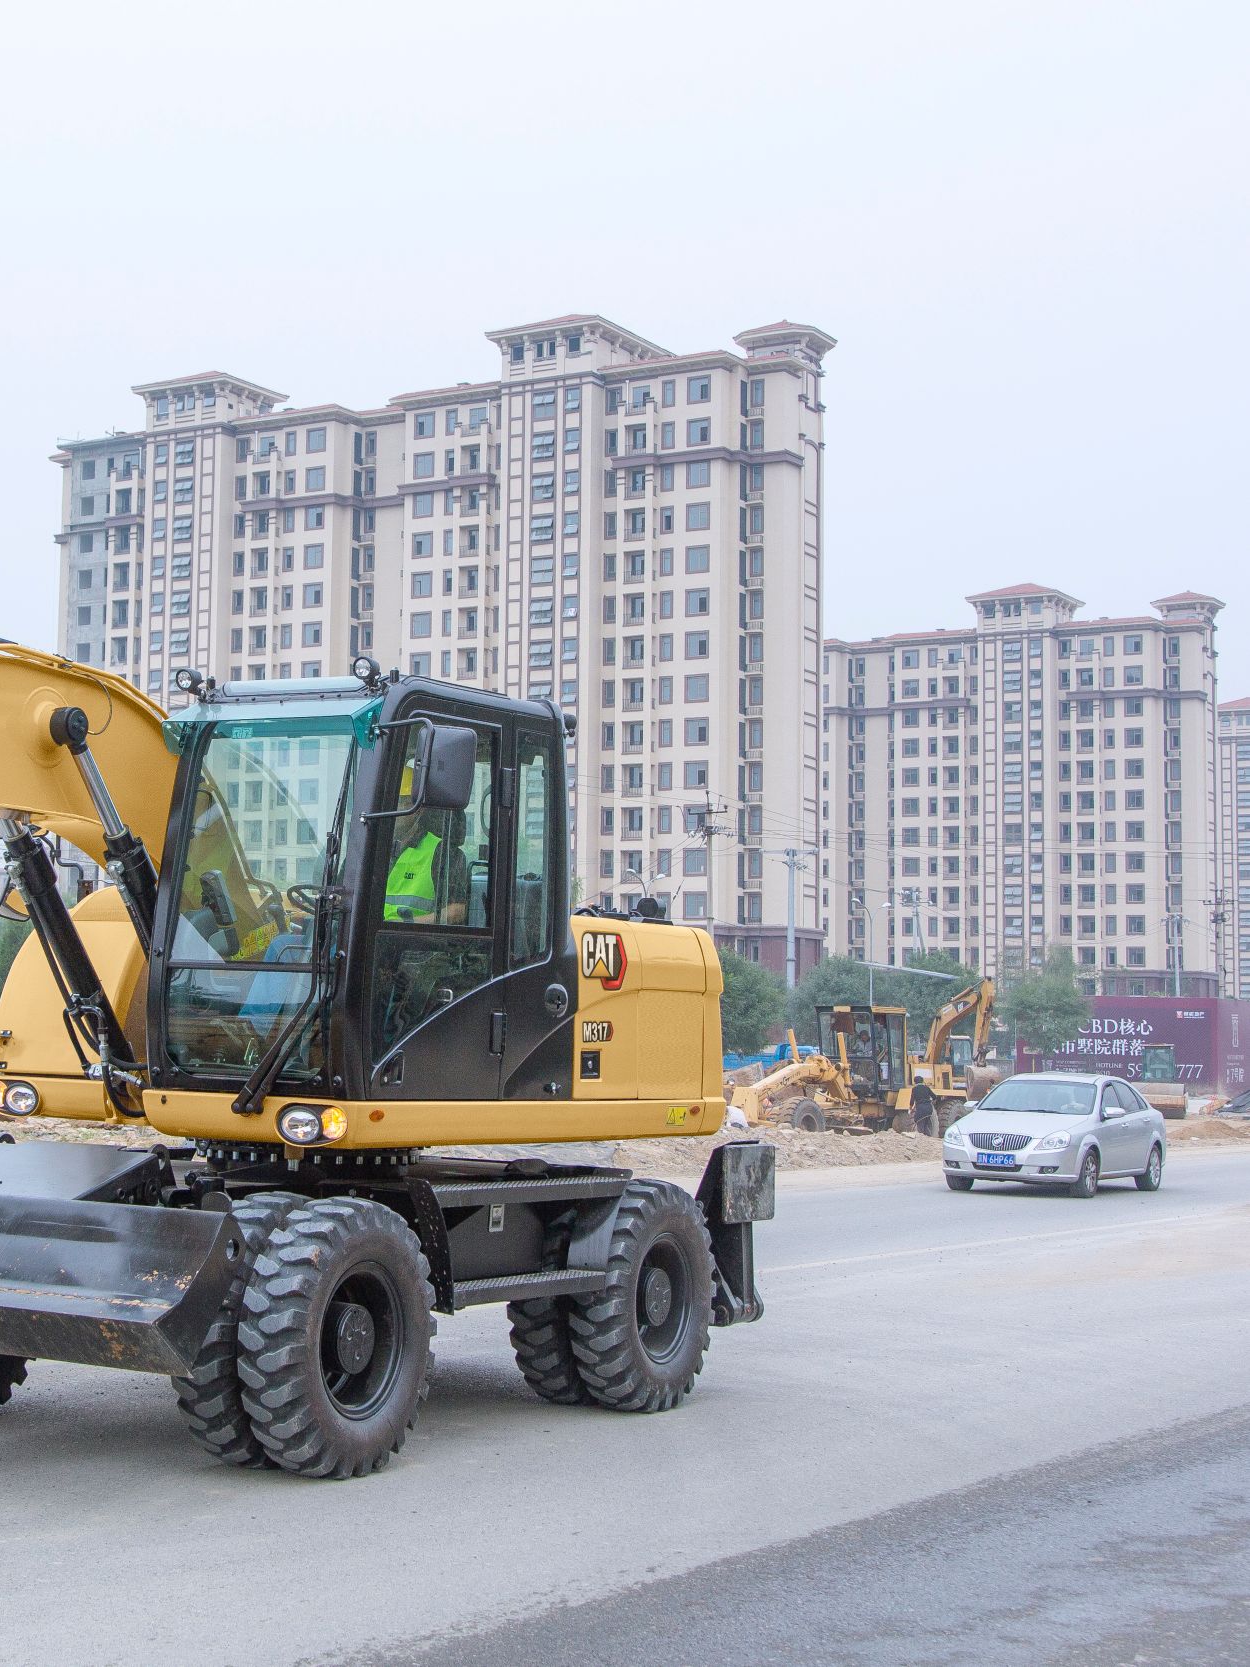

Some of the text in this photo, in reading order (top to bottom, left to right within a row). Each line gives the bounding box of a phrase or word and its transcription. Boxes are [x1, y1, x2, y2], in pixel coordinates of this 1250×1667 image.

[582, 933, 617, 977] CAT
[583, 1022, 610, 1042] M317
[1052, 1038, 1146, 1057] 市墅院群落
